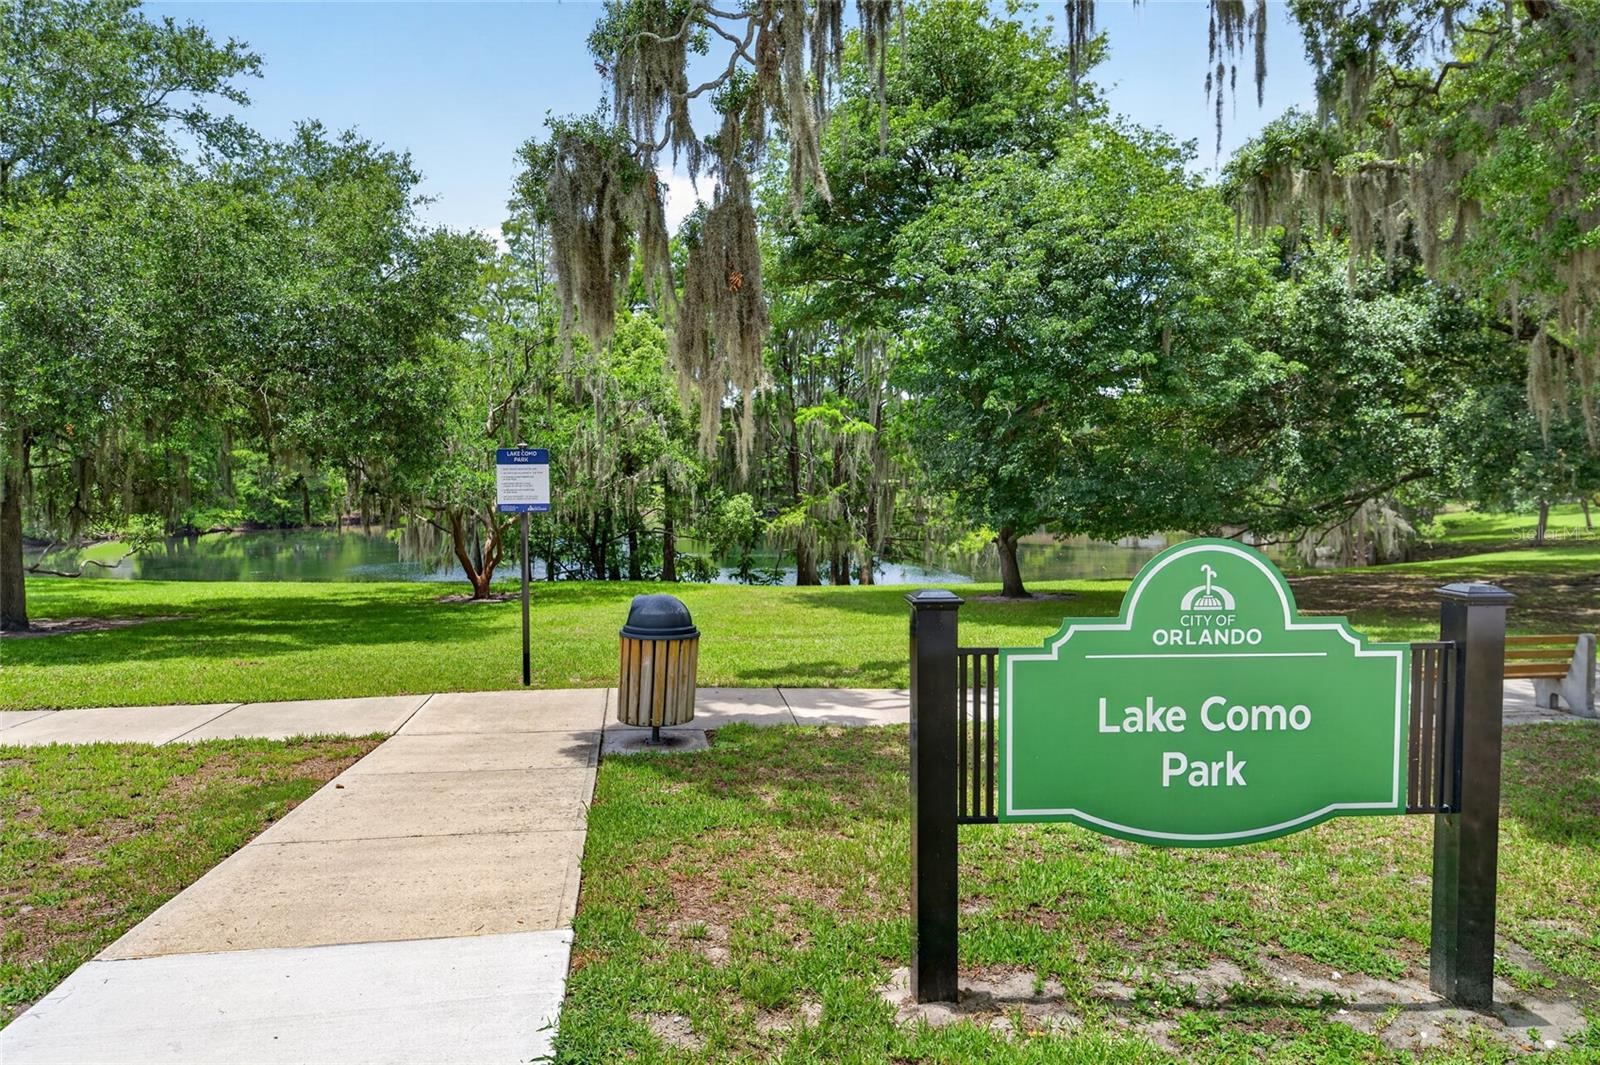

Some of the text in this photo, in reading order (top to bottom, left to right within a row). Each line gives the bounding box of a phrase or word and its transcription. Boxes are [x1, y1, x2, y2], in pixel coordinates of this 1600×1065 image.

[1180, 614, 1236, 627] CITY OF
[1152, 628, 1262, 646] ORLANDO
[1098, 696, 1312, 733] Lake Como
[1162, 751, 1247, 787] Park
